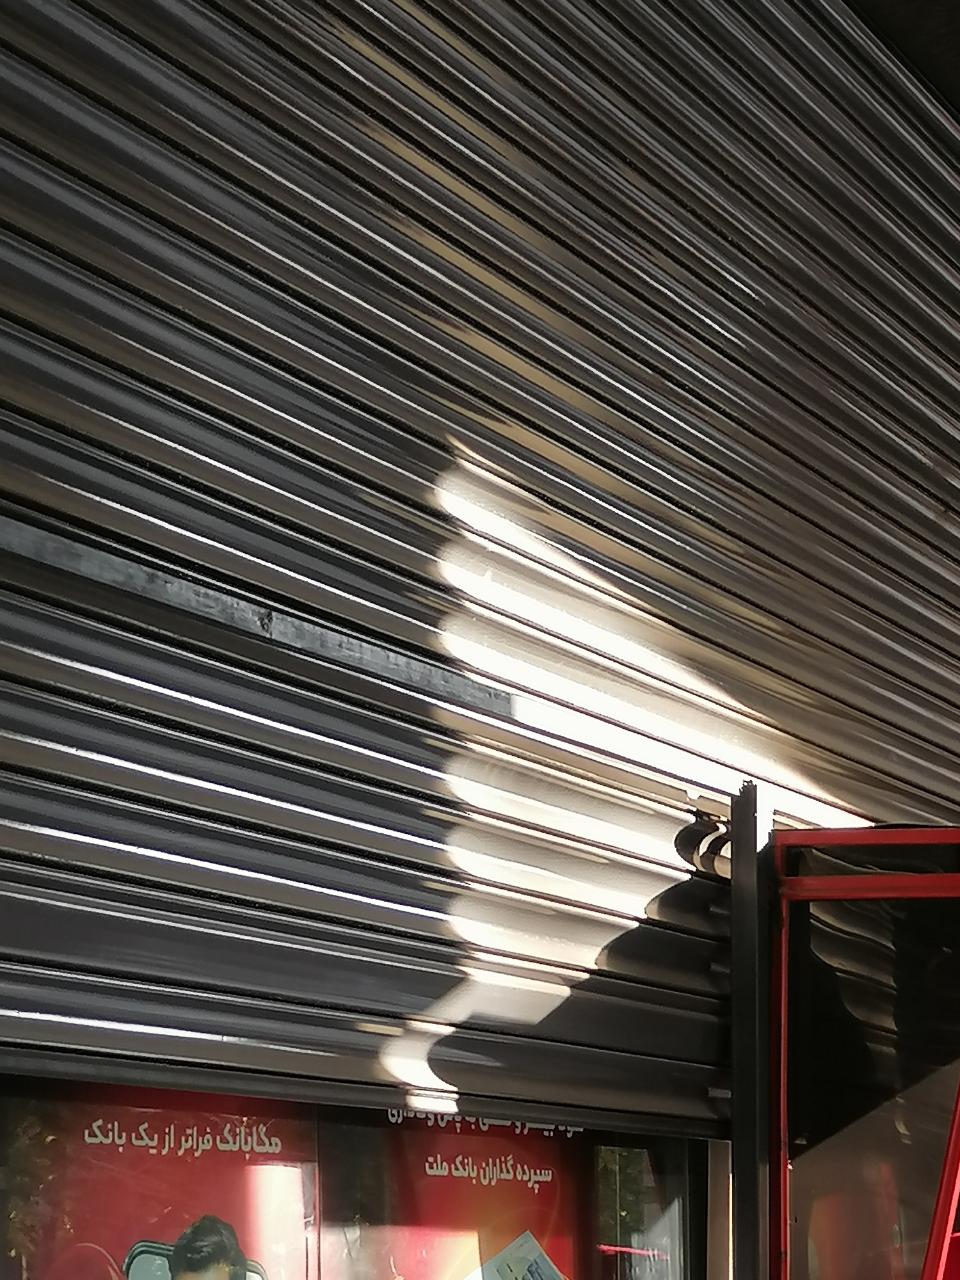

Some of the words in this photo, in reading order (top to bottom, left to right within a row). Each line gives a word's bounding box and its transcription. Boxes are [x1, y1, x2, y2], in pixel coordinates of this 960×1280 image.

[84, 1118, 127, 1152] بانک
[131, 1121, 158, 1154] یک
[161, 1123, 175, 1155] از
[177, 1125, 213, 1158] فراتر
[424, 1153, 449, 1177] ملت
[451, 1154, 477, 1184] بانک
[480, 1154, 514, 1187] گذاران
[516, 1163, 553, 1194] سپرده
